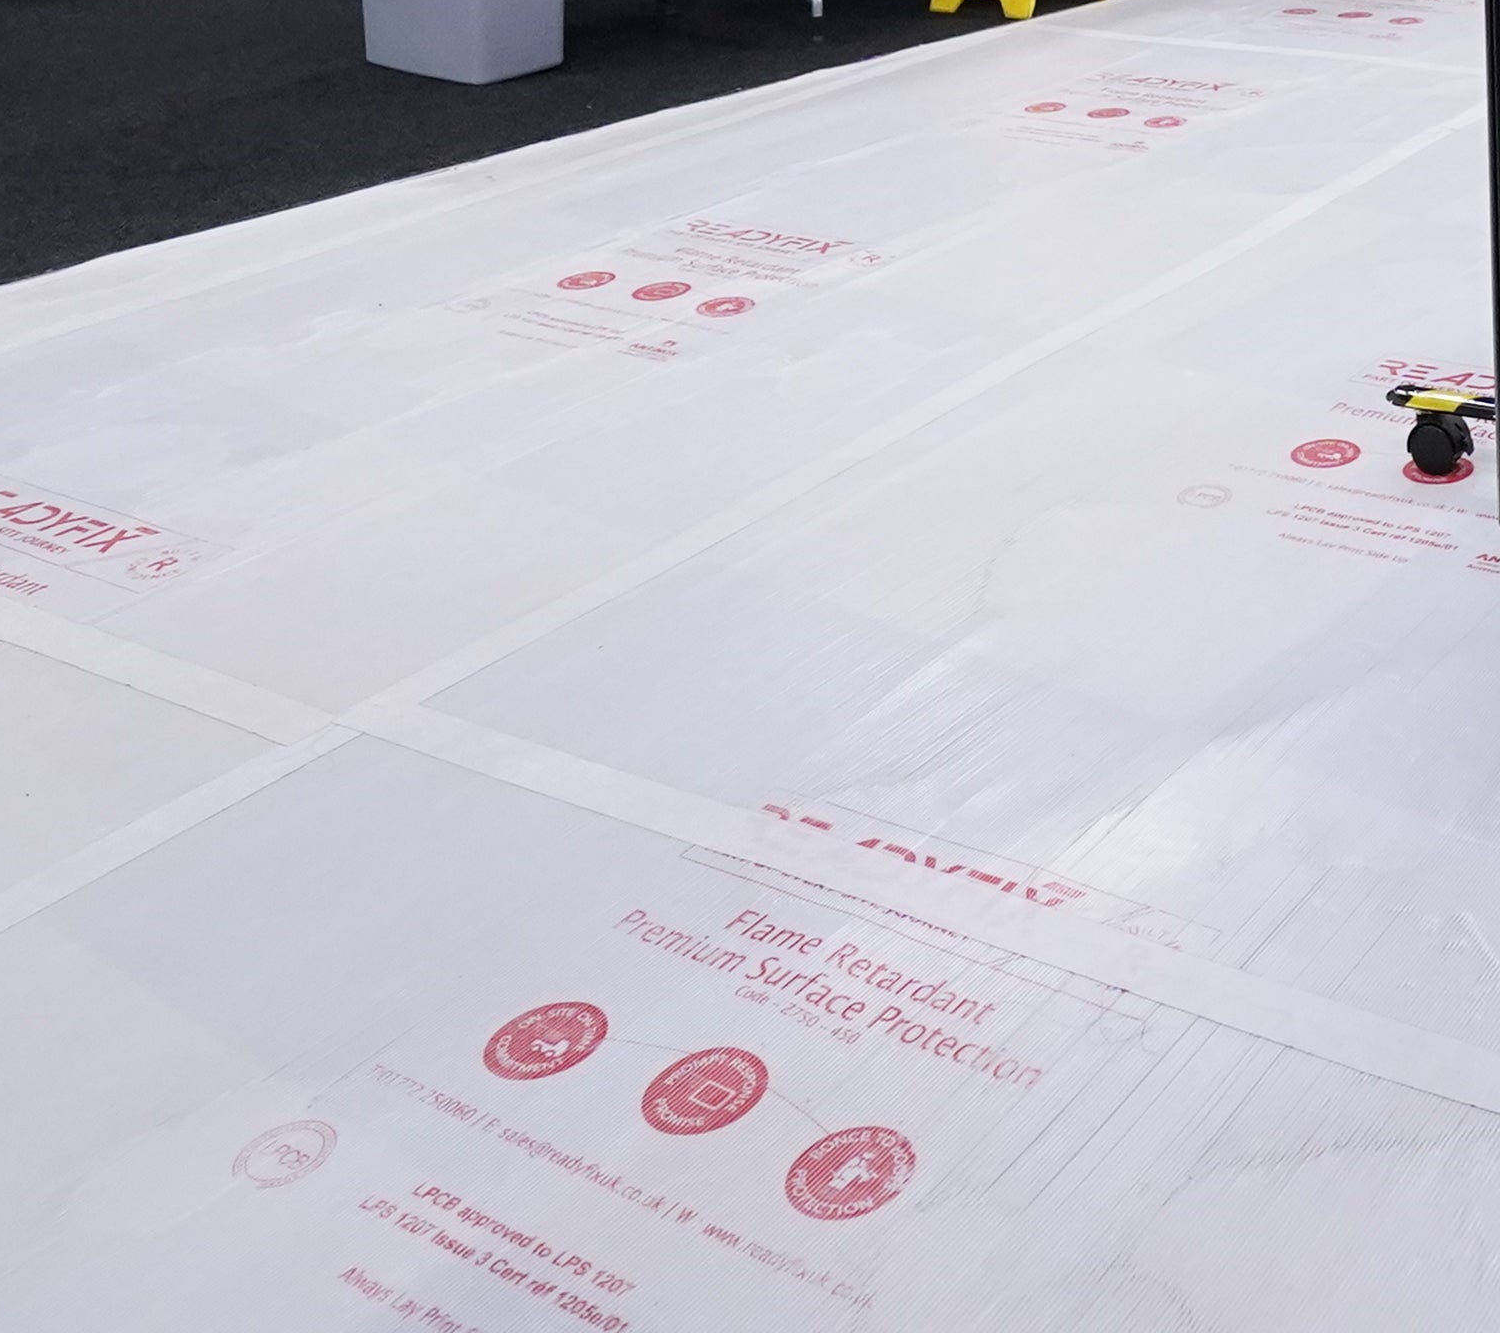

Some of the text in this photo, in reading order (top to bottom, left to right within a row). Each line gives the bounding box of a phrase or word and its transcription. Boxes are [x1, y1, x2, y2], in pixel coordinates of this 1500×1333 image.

[686, 219, 853, 255] READYFIX
[613, 908, 1043, 1091] Premium Surface Protection
[723, 909, 996, 1028] Flame Retardant
[733, 984, 770, 1008] Code
[779, 1001, 821, 1028] 2750
[829, 1027, 860, 1046] 450
[358, 1193, 399, 1220] LPS
[391, 1210, 439, 1240] 1207
[428, 1228, 479, 1260] Issue
[472, 1249, 494, 1268] 3
[484, 1256, 531, 1286] Cert
[523, 1275, 558, 1300] ref
[410, 1180, 638, 1299] LPCB approved to LPS 1207
[332, 1264, 468, 1333] Always Lay Print
